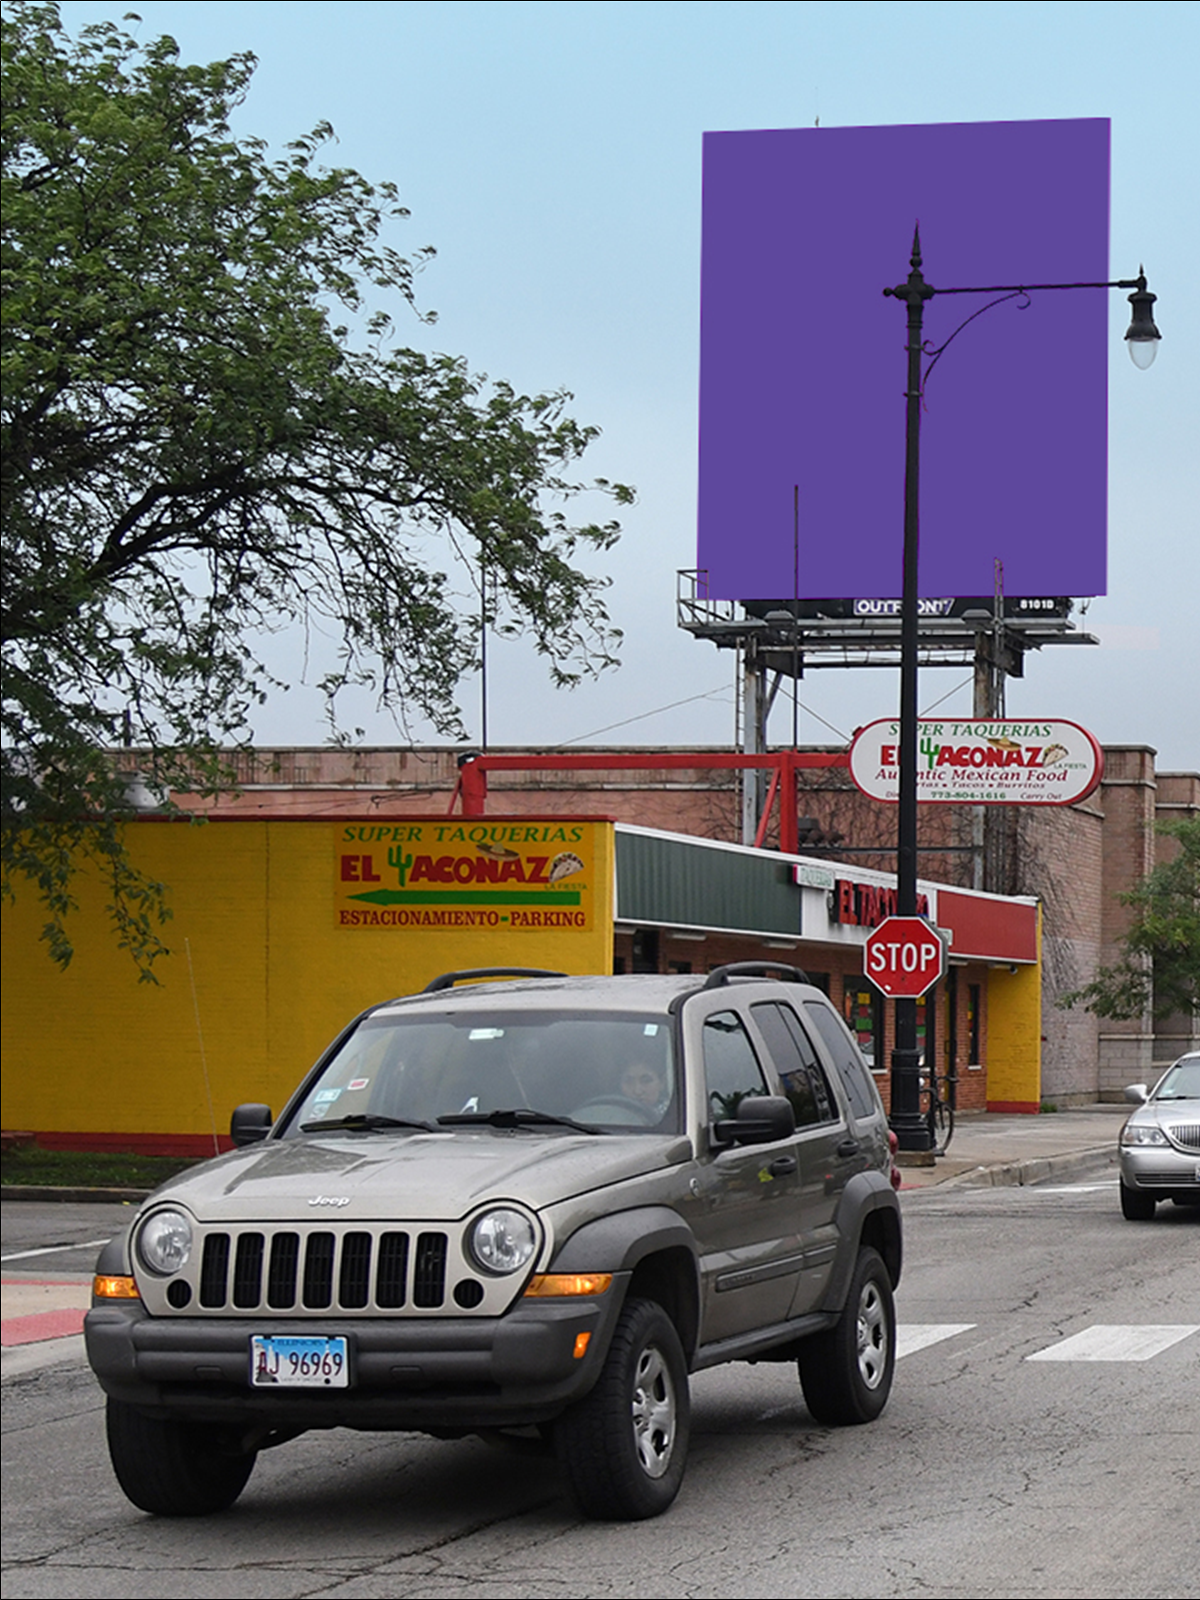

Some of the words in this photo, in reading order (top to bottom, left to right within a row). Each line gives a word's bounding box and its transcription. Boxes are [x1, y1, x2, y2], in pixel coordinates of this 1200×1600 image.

[857, 599, 948, 614] OUTFONT
[951, 723, 1052, 739] TAQUERIAS
[881, 745, 901, 766] E
[951, 768, 1020, 781] Mexican
[1026, 769, 1068, 782] Food
[342, 826, 422, 842] SUPER
[434, 826, 584, 843] TAQUERIAS
[340, 855, 380, 882] EL
[870, 942, 936, 973] STOP
[308, 1195, 350, 1208] Jeep
[289, 1352, 343, 1376] 96969
